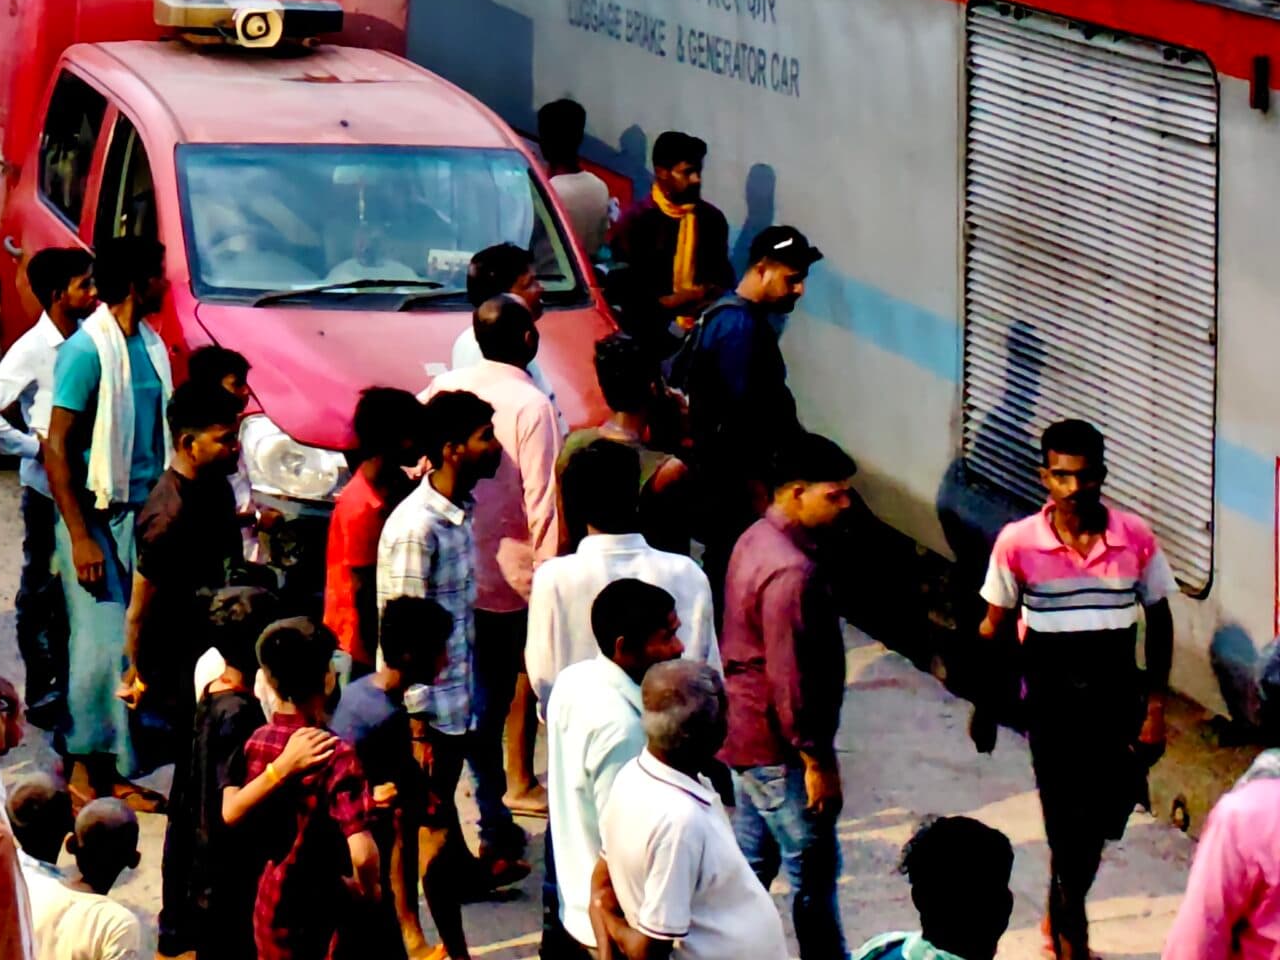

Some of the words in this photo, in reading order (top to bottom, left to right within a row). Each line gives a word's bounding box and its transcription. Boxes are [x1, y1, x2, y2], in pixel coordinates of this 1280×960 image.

[626, 8, 667, 58] BRAKE
[676, 25, 686, 63] &
[687, 28, 768, 89] GENERATOR
[771, 52, 801, 98] CAR
